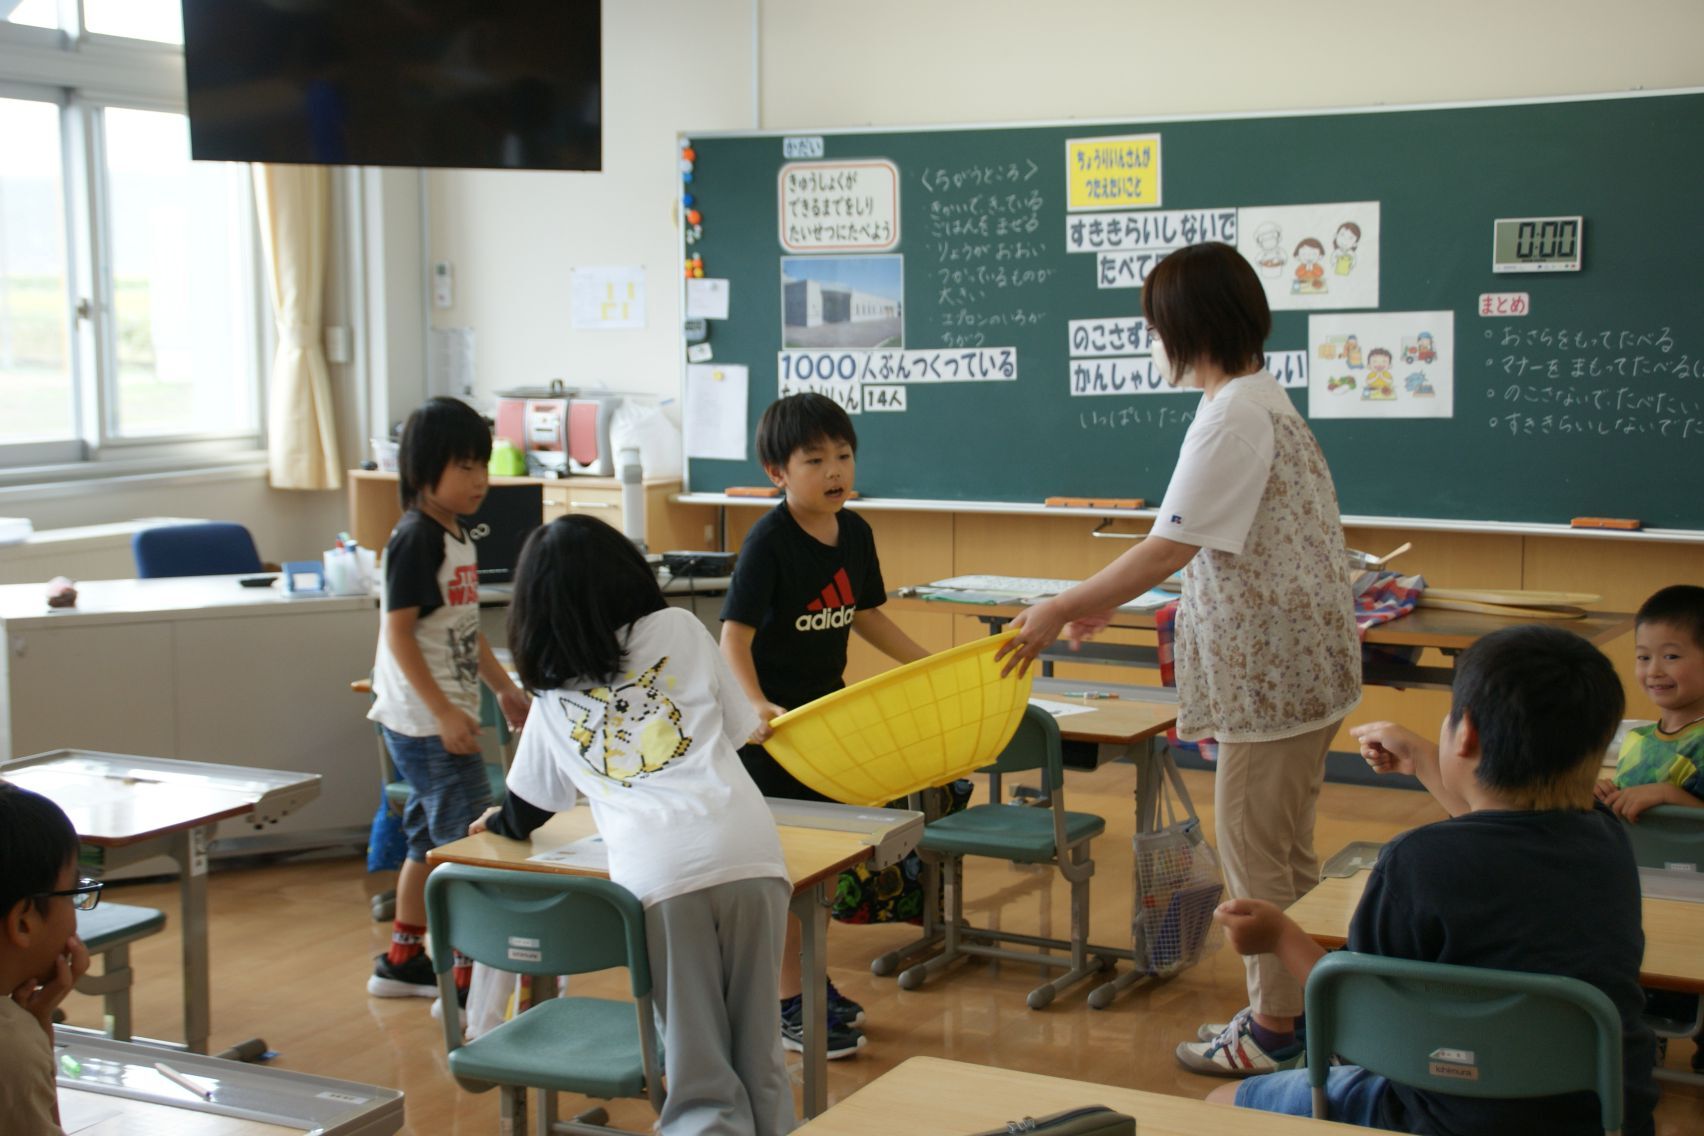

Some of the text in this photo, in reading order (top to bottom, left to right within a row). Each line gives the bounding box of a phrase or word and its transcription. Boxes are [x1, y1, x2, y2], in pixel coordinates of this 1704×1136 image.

[786, 138, 821, 155] かだい
[1076, 146, 1151, 172] ちょうりいんさんが
[789, 171, 858, 193] きゅうしょくが
[1085, 176, 1142, 200] つたえたいこと
[789, 196, 874, 218] できるまでをしり
[789, 221, 891, 242] たいせつにたべよう
[1069, 212, 1236, 248] すききらいしないで
[1516, 220, 1578, 259] 0:00
[1100, 253, 1163, 286] たべて
[1481, 296, 1526, 315] まとめ
[1074, 321, 1153, 351] のこさず
[867, 389, 903, 408] 14人
[795, 605, 857, 632] adida
